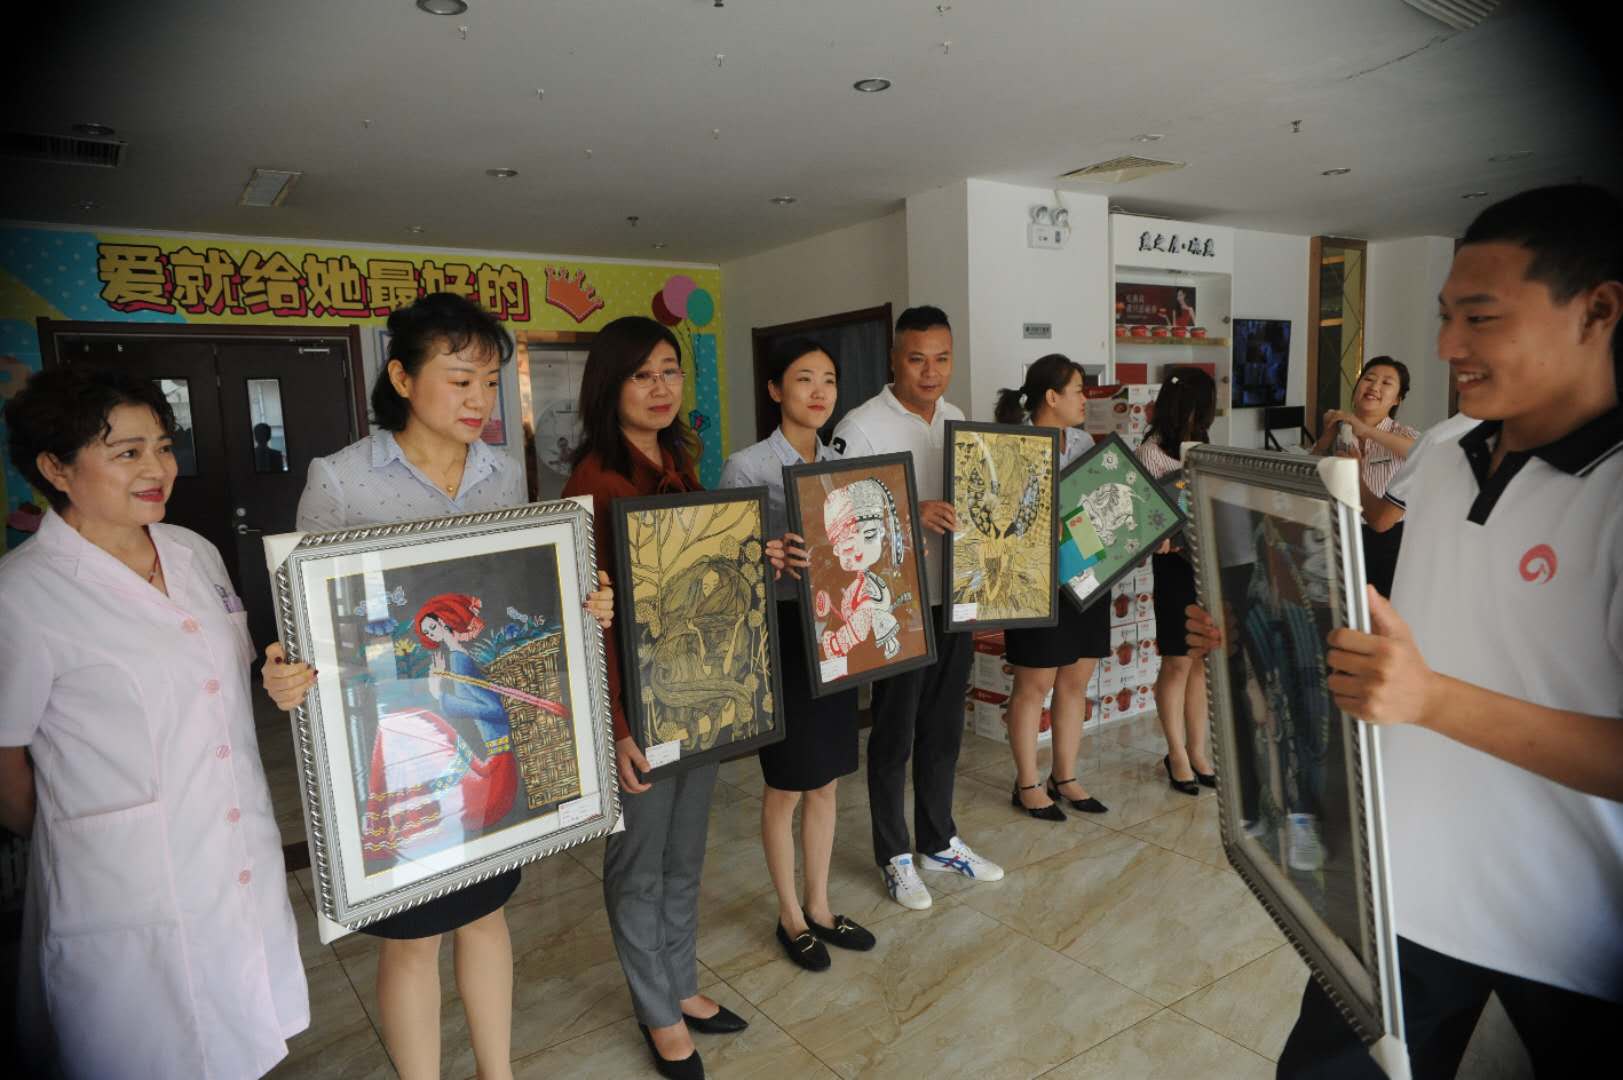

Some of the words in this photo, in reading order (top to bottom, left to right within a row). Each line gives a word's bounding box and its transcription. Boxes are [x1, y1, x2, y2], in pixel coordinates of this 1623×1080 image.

[97, 243, 530, 321] 爱就给她最好的
